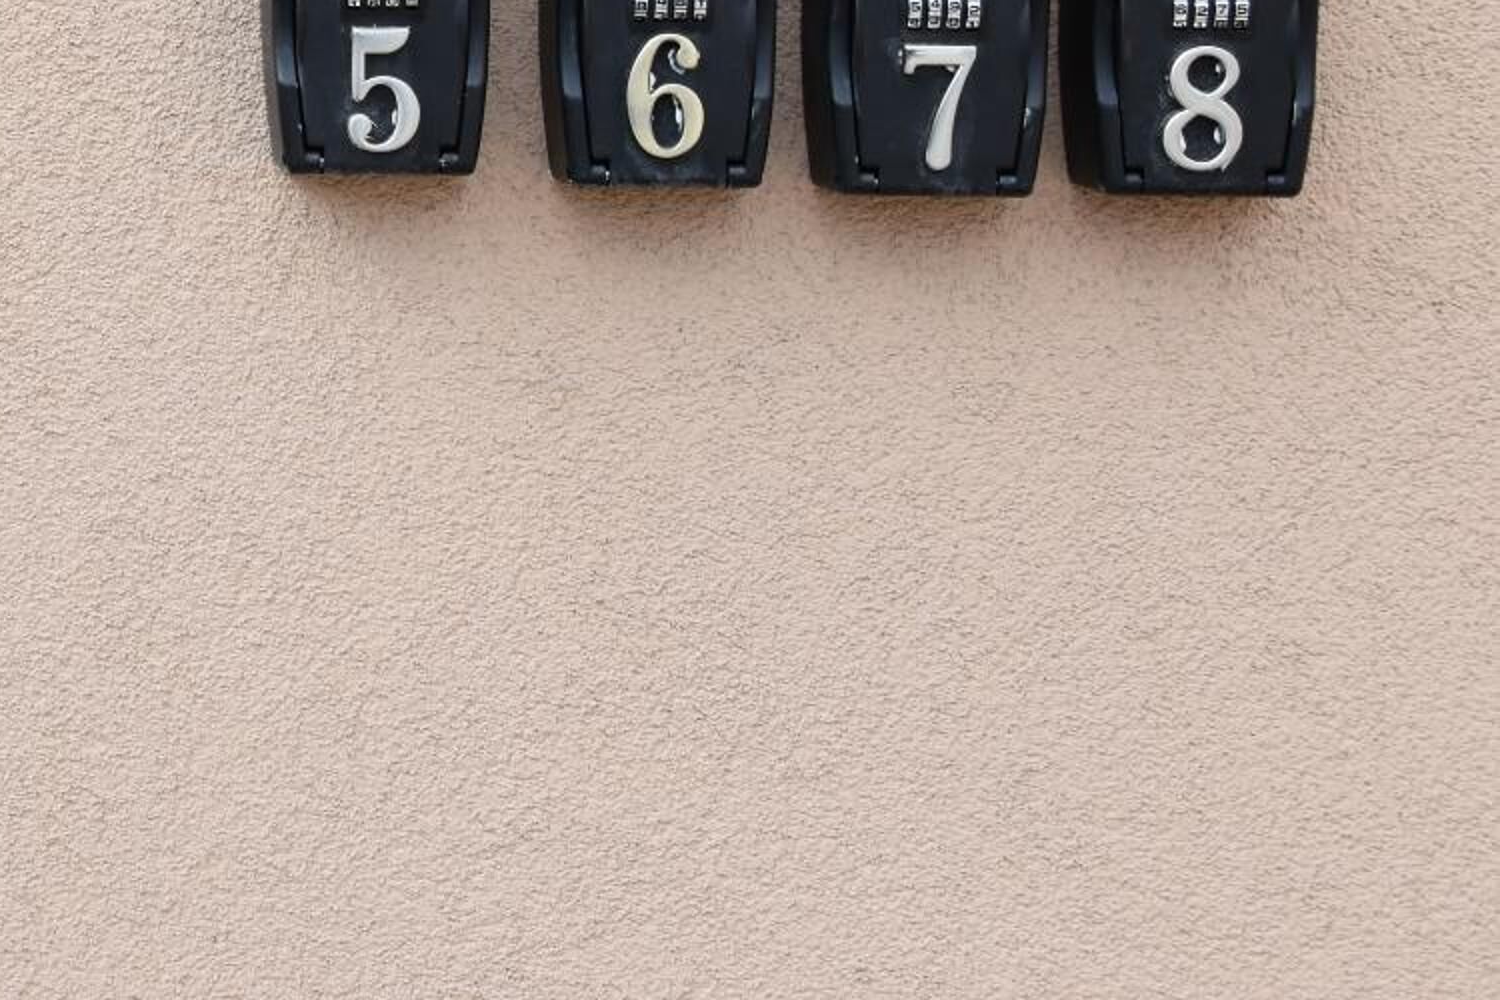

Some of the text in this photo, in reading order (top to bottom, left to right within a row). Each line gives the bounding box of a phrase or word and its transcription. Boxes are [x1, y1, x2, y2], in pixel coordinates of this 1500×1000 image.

[348, 24, 421, 153] 5
[627, 33, 705, 159] 6
[902, 44, 977, 171] 7
[1163, 45, 1244, 172] 8
